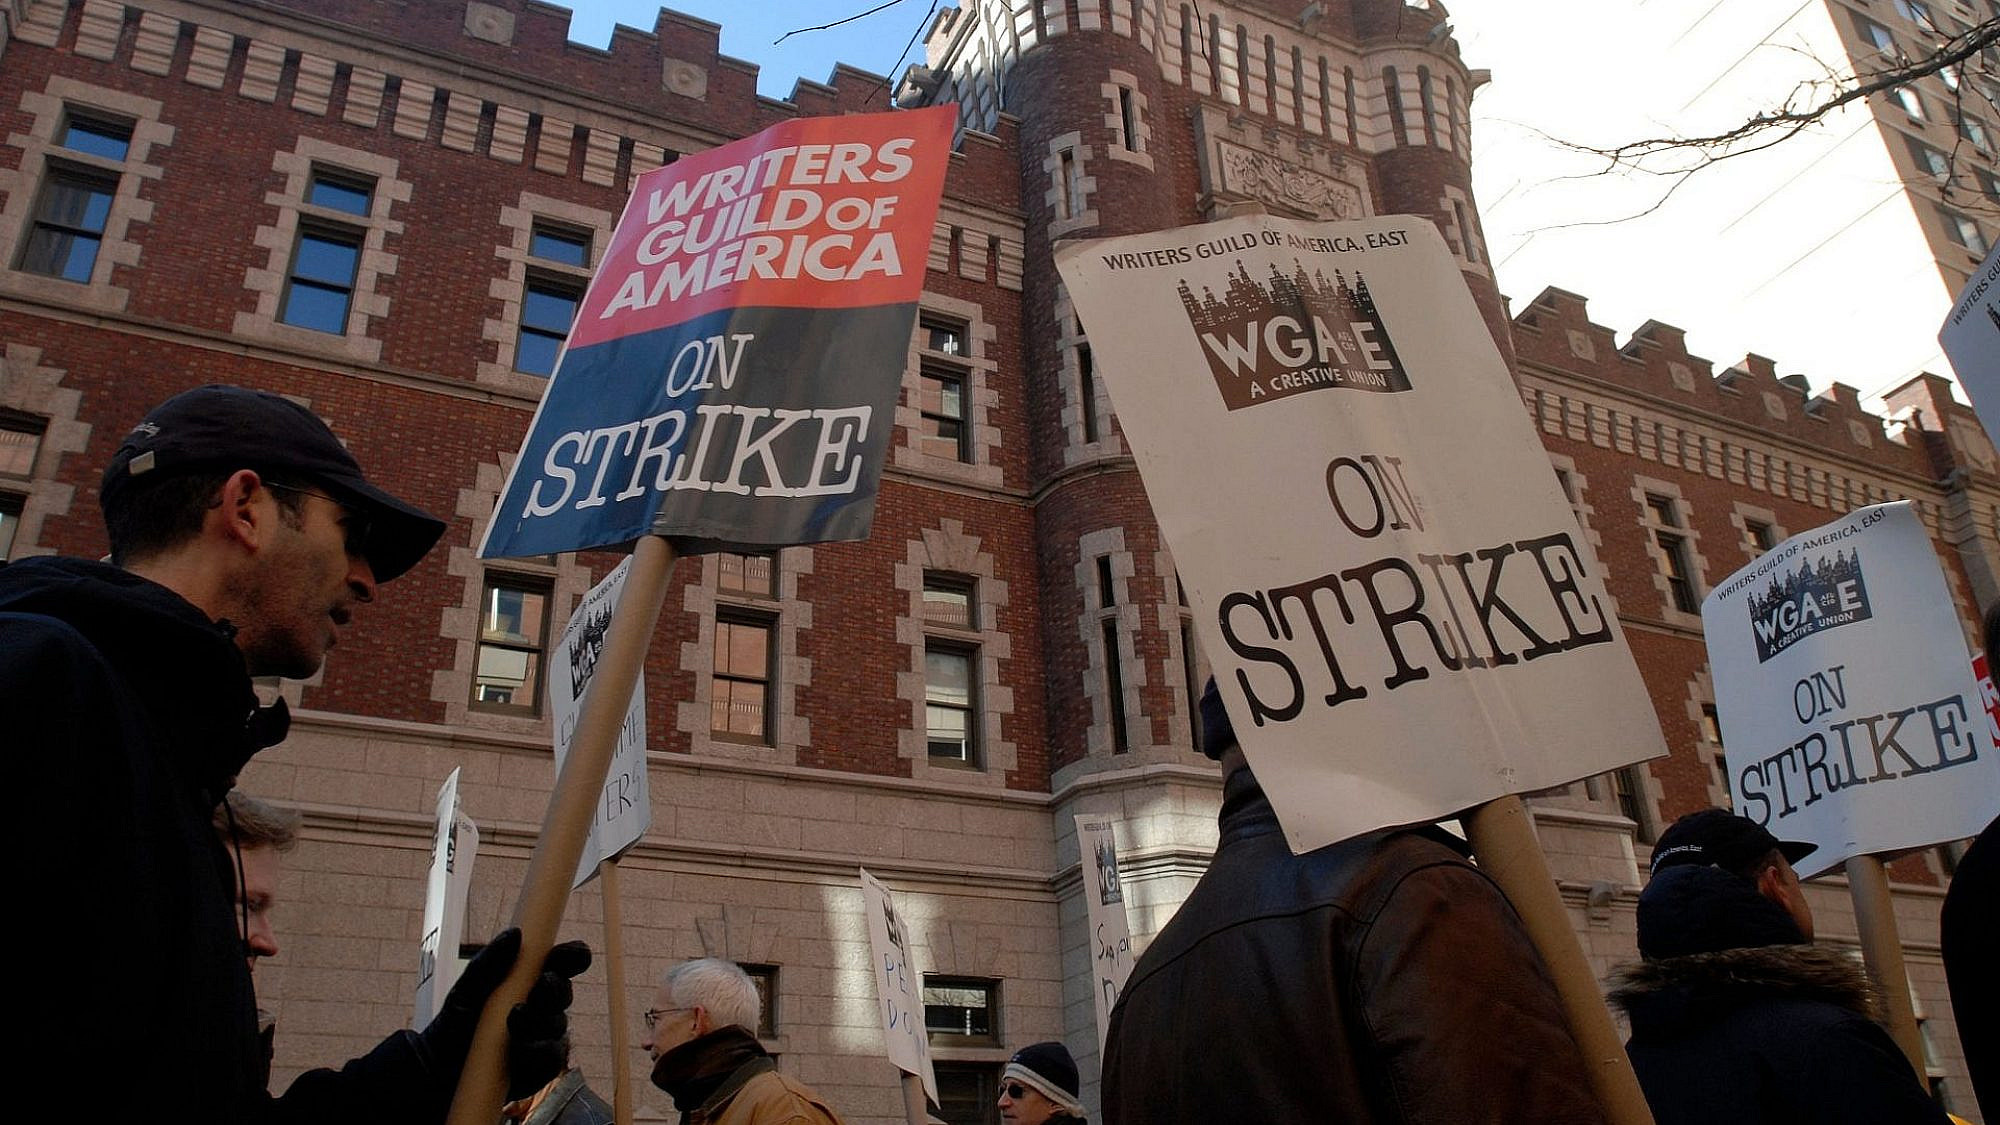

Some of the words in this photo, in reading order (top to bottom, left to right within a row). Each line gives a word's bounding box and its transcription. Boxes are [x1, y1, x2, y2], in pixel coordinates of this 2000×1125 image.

[647, 138, 915, 225] WRITERS
[636, 189, 823, 266] GUILD
[824, 195, 900, 231] OF
[1102, 247, 1192, 270] WRITERS
[1196, 232, 1258, 259] GUILD
[1261, 230, 1283, 246] OF
[1287, 233, 1364, 253] AMERICA,
[1366, 230, 1409, 248] EAST
[599, 232, 903, 319] AMERICA
[1953, 278, 1989, 326] WRITERS
[666, 333, 754, 398] ON
[1250, 382, 1267, 399] A
[1270, 368, 1343, 391] CREATIVE
[1348, 369, 1387, 387] UNION
[522, 404, 873, 519] STRIKE
[1325, 455, 1425, 539] ON
[1718, 571, 1756, 601] WRITERS
[1757, 553, 1784, 577] GUILD
[1785, 544, 1801, 558] OF
[1802, 523, 1862, 552] AMERICA,
[1862, 507, 1888, 528] EAST
[1218, 533, 1614, 728] STRIKE
[1769, 644, 1777, 655] A
[1777, 622, 1814, 648] CREATIVE
[1818, 611, 1853, 627] UNION
[1794, 665, 1846, 725] ON
[1740, 694, 1978, 828] STRIKE
